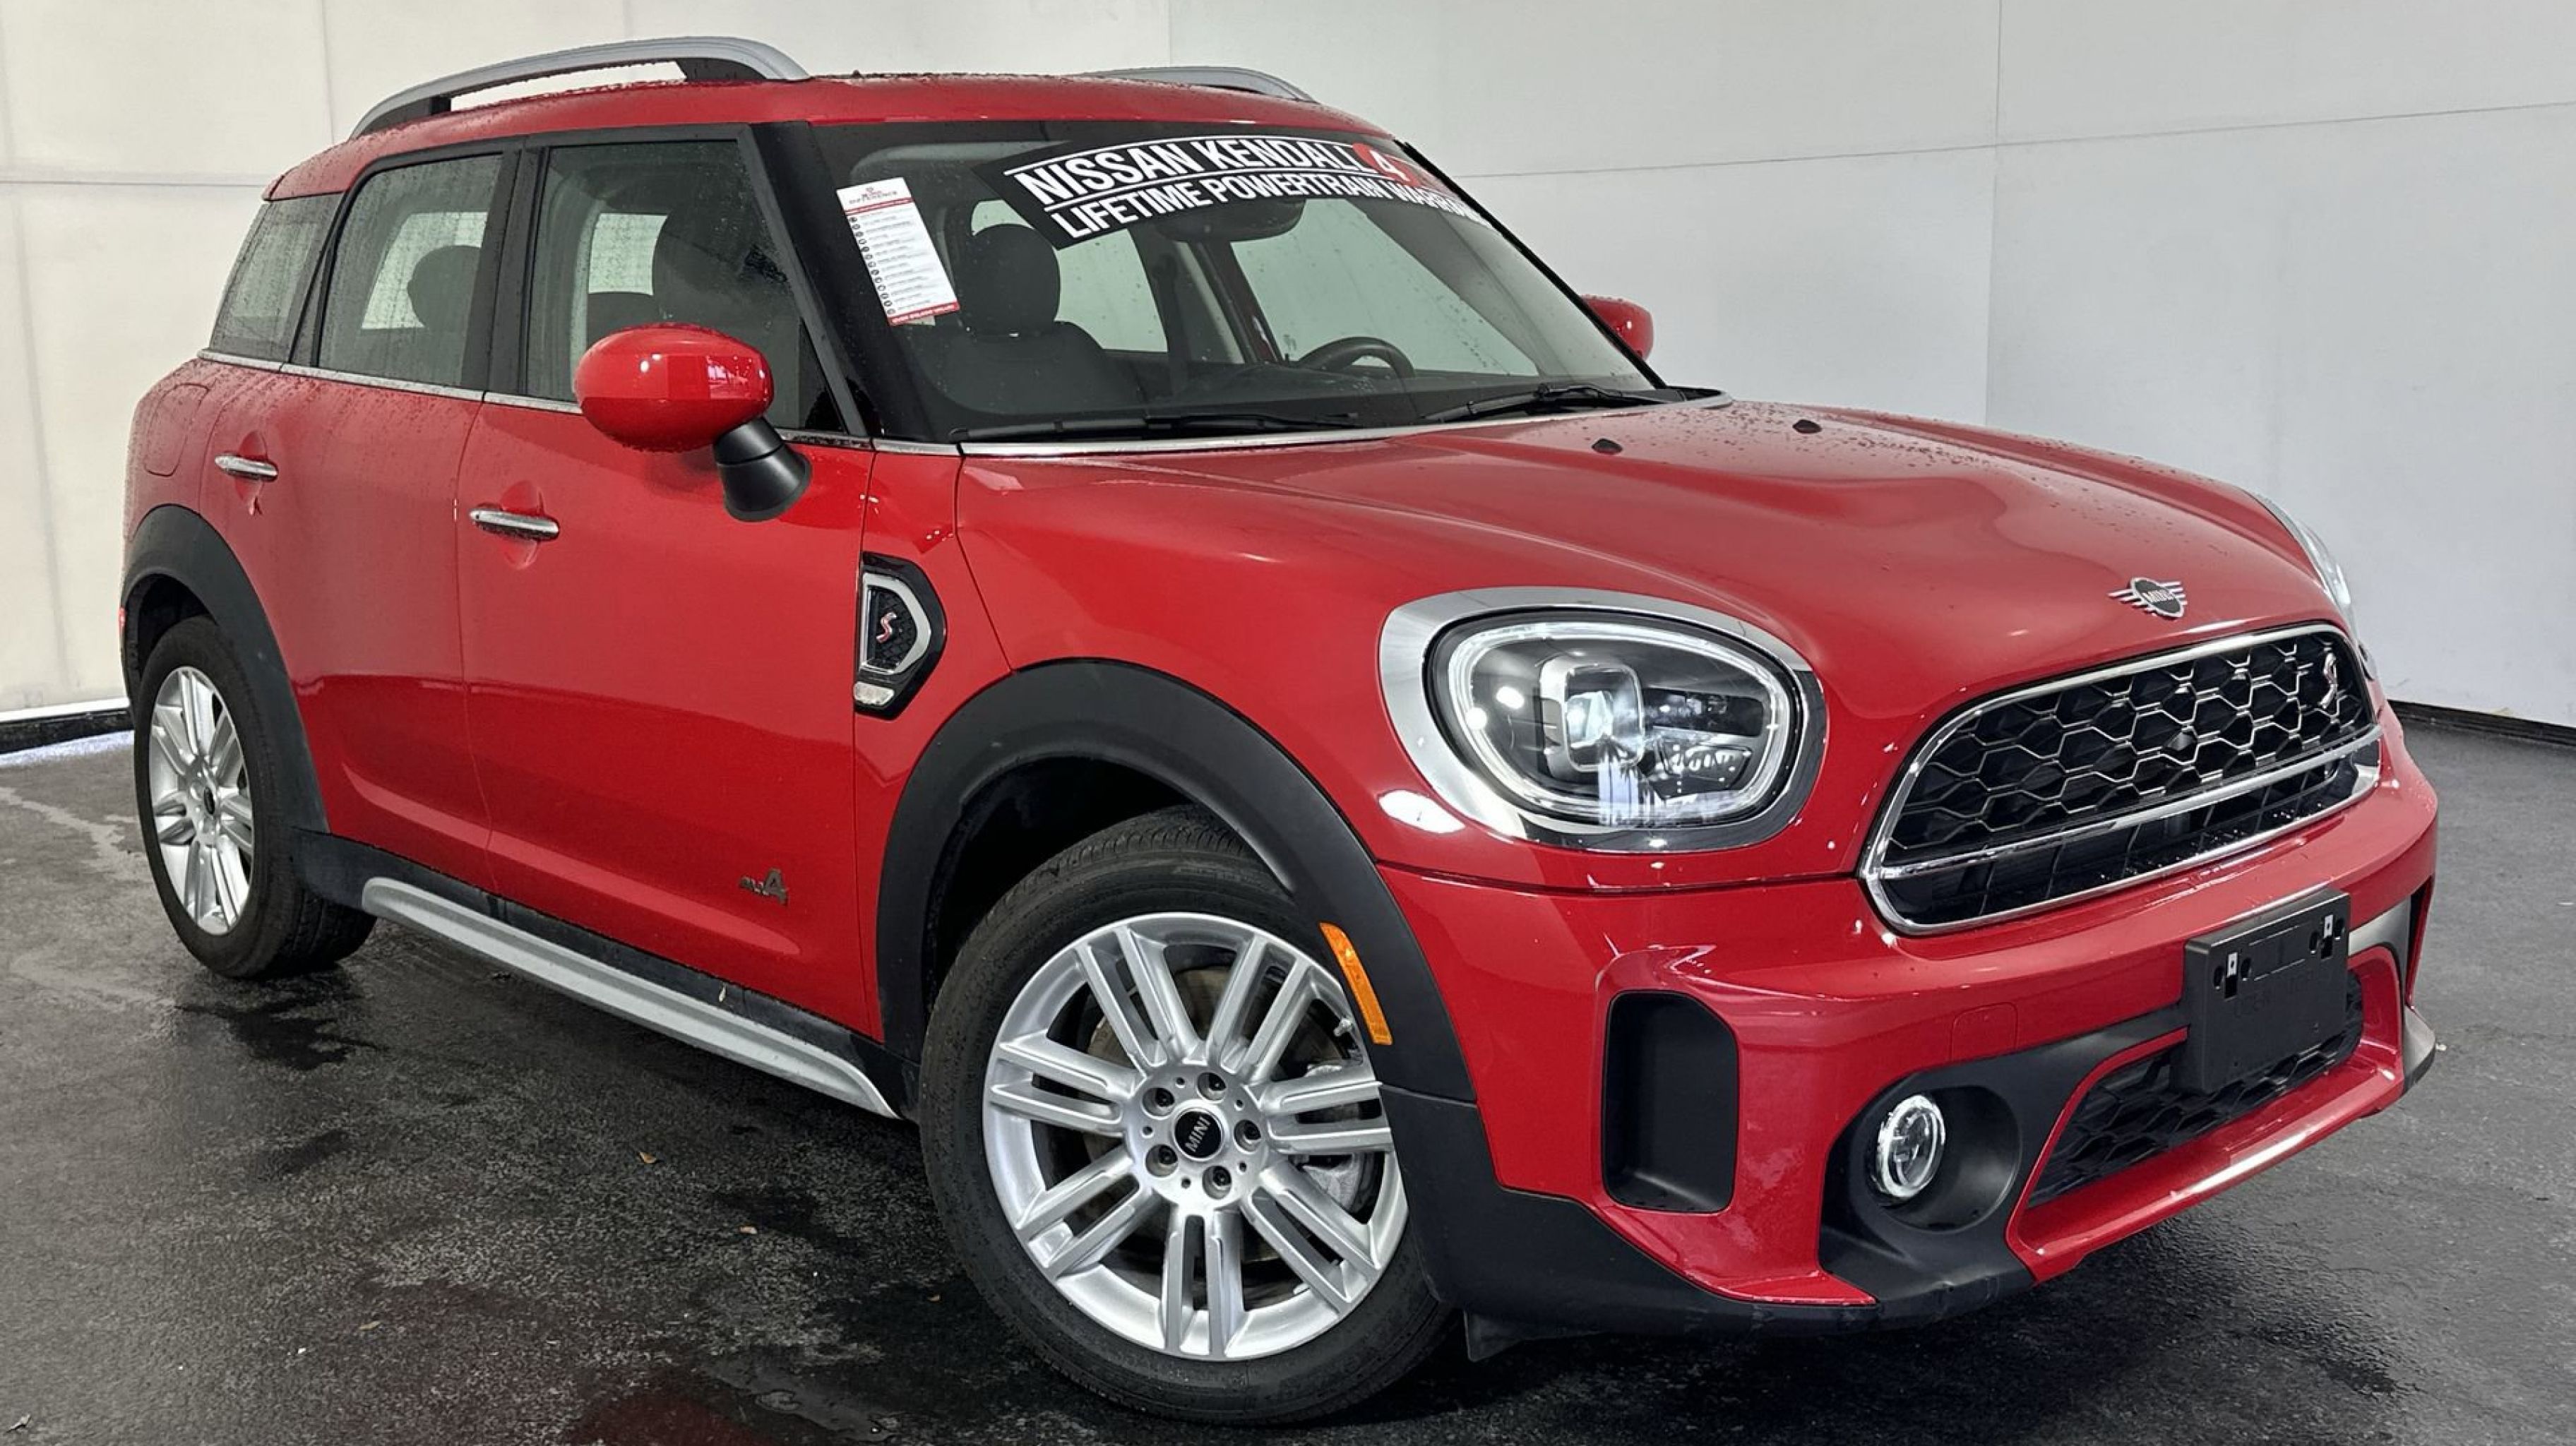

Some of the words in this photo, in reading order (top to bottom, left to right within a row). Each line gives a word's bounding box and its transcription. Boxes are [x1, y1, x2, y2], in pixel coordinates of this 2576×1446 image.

[1014, 143, 1205, 205] NISSAN
[1190, 139, 1378, 174] KENDALL
[1051, 182, 1213, 238] LIFETIME
[1199, 174, 1394, 203] POWERTRAIN
[1185, 1116, 1211, 1152] MINI
